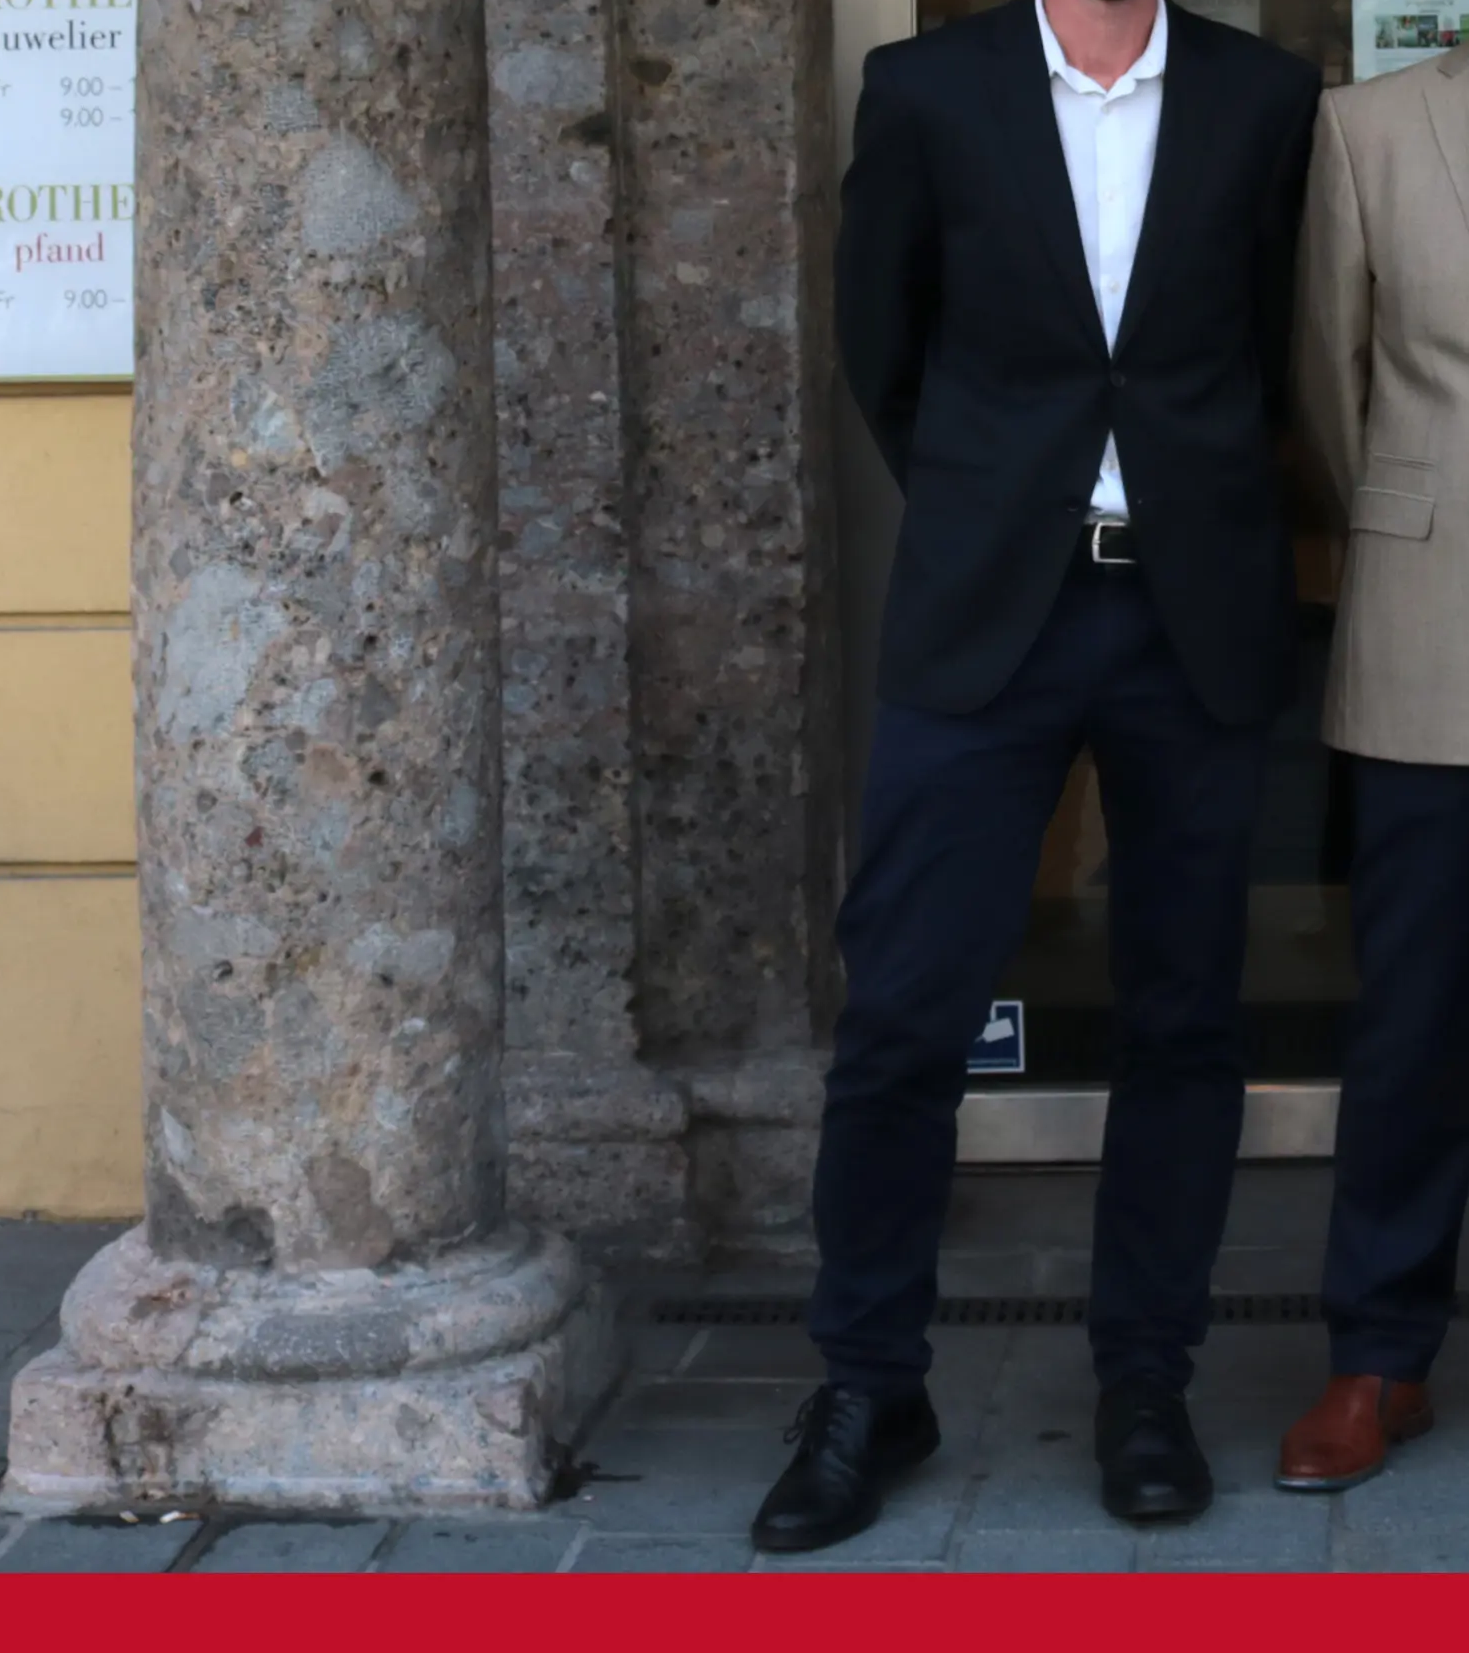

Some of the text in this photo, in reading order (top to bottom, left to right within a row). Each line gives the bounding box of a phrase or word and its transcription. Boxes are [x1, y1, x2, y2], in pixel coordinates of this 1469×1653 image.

[59, 76, 104, 97] 9.00
[60, 108, 104, 128] 9.00
[14, 231, 105, 272] pfand
[63, 289, 108, 310] 9.00
